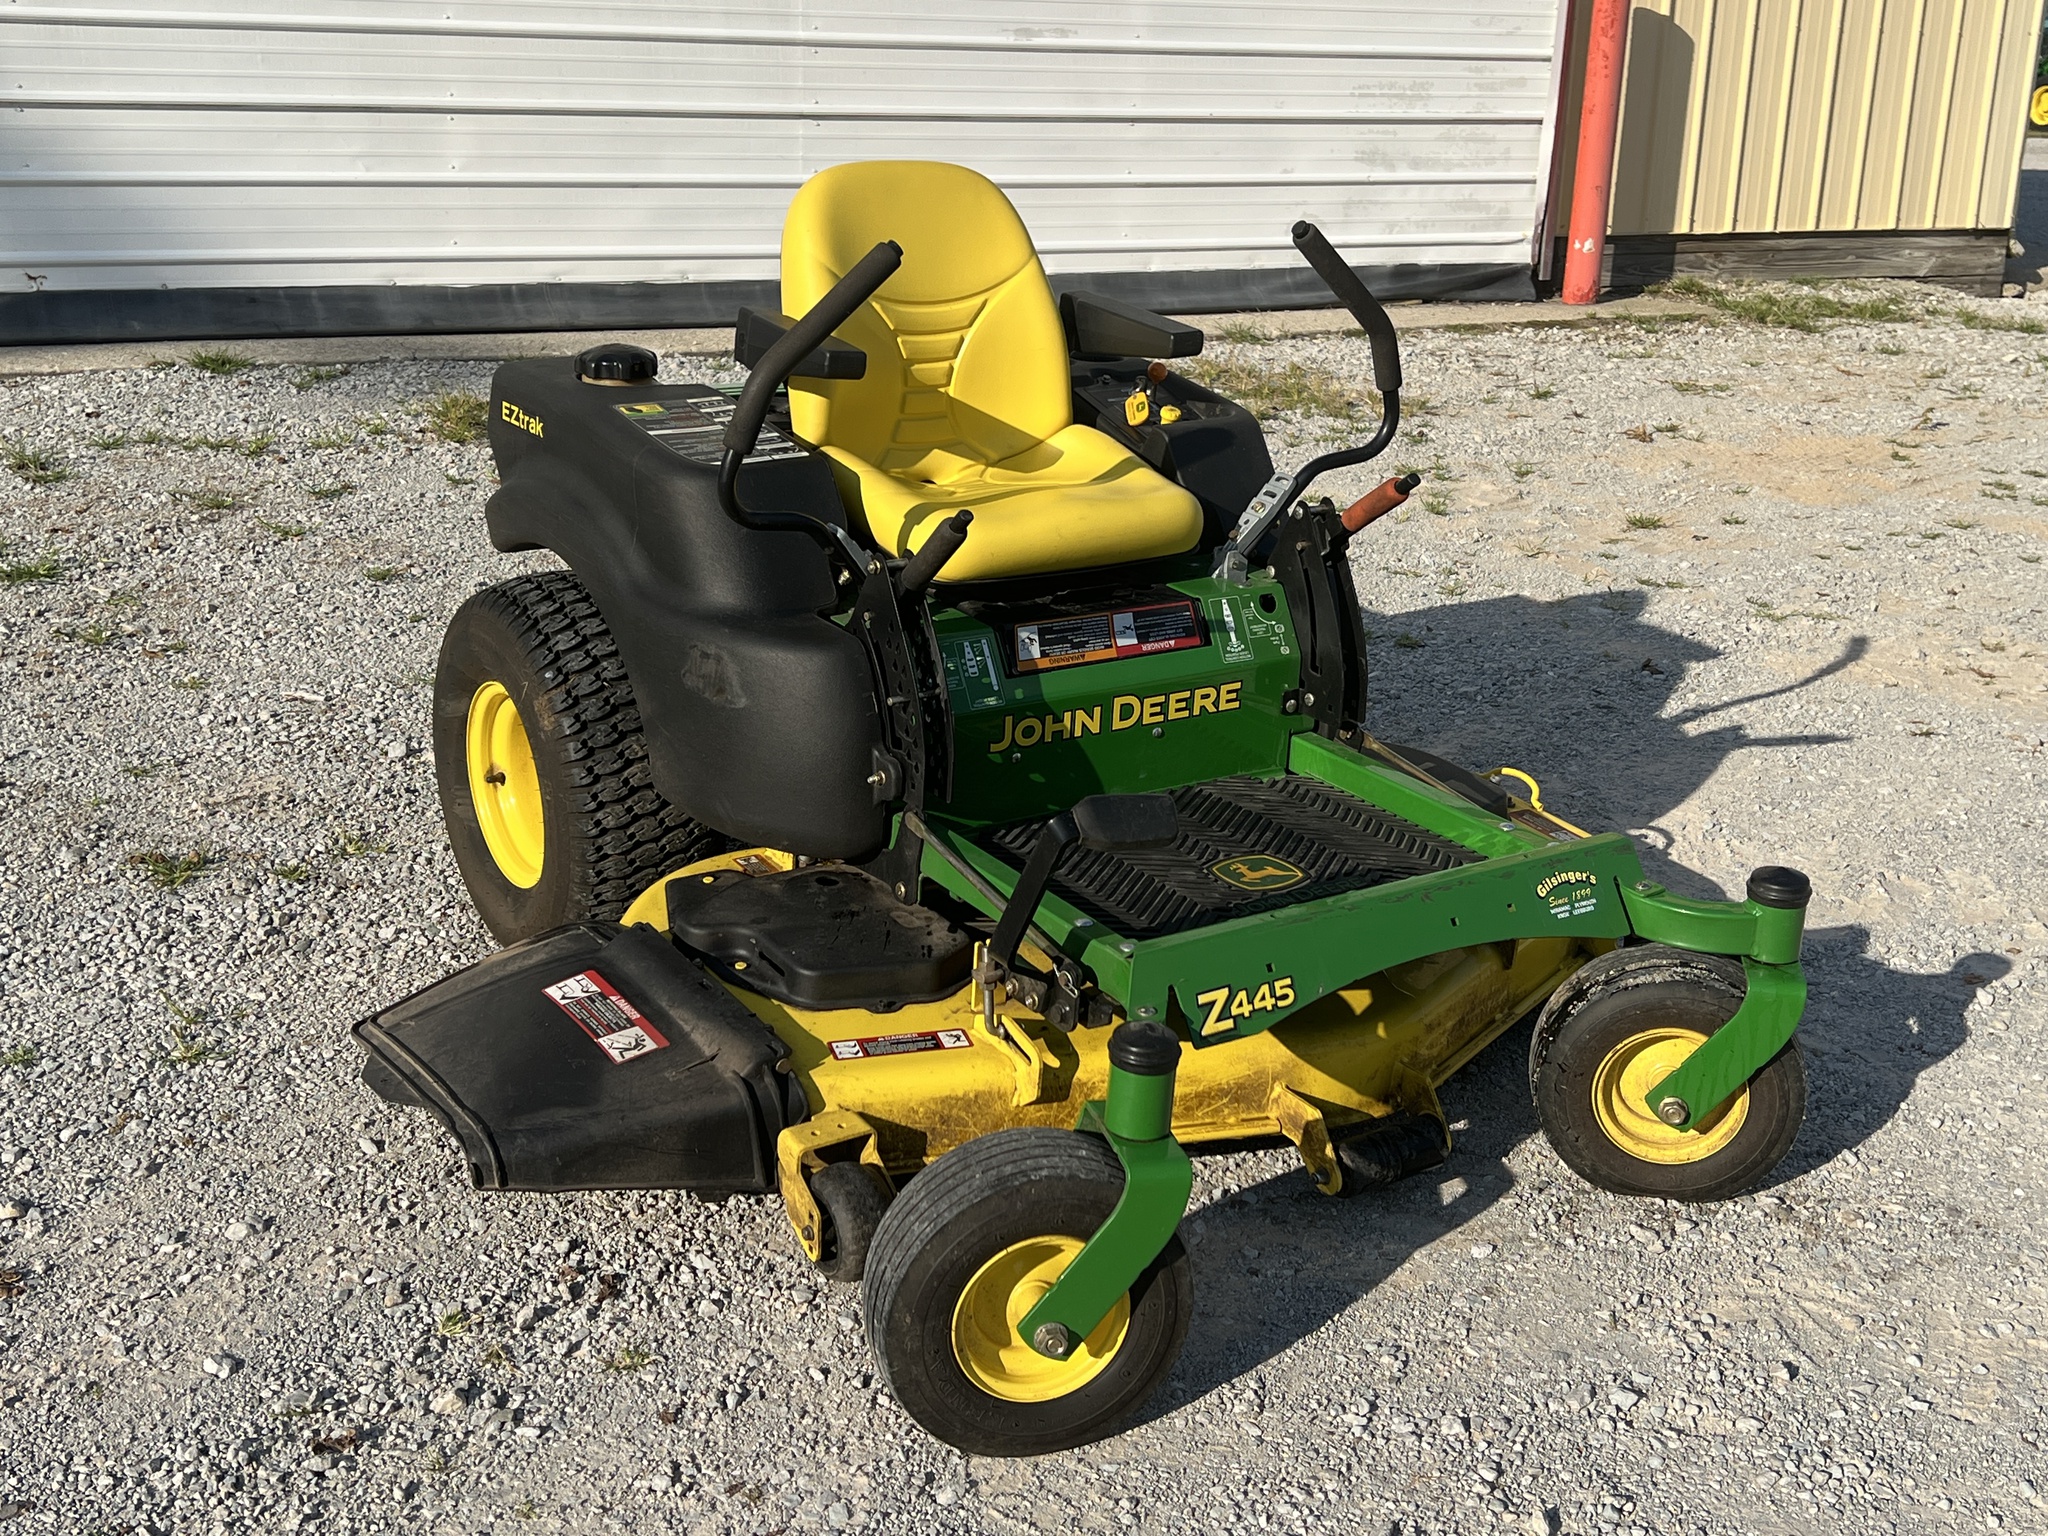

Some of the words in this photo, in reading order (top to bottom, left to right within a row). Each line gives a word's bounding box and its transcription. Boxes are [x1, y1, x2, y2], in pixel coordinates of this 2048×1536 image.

[501, 400, 544, 438] EZtrak
[1141, 640, 1169, 652] DANGER
[1048, 654, 1081, 665] WARNING
[990, 706, 1102, 752] JOHN
[1111, 681, 1243, 731] DEERE
[1294, 878, 1366, 900] DEERE
[1536, 870, 1597, 898] Gilsinger's
[1549, 896, 1569, 907] Since
[1572, 888, 1591, 901] 1899
[615, 998, 641, 1020] DANGER
[1196, 976, 1296, 1037] Z445
